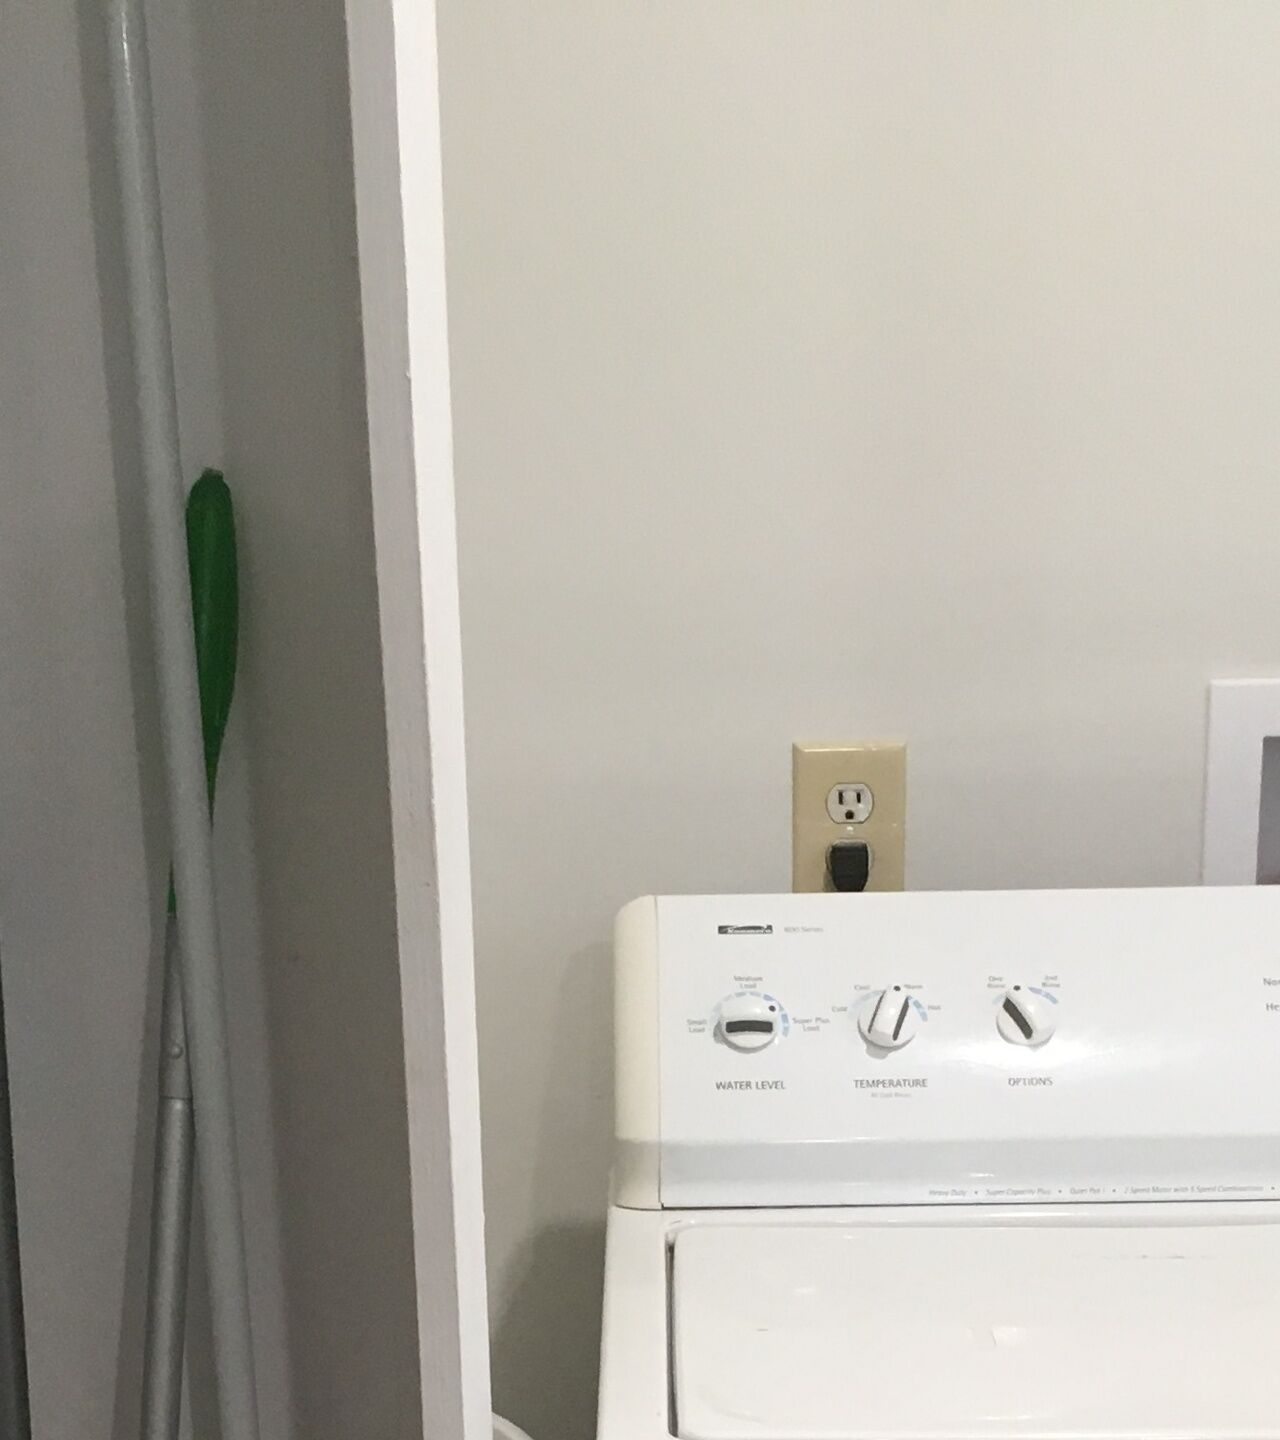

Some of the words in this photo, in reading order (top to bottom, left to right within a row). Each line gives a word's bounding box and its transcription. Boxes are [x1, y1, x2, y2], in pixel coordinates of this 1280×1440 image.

[715, 1081, 752, 1090] WATER
[756, 1080, 786, 1089] LEVEL
[854, 1079, 928, 1089] TEMPERATURE
[1008, 1077, 1053, 1086] OPTIONS
